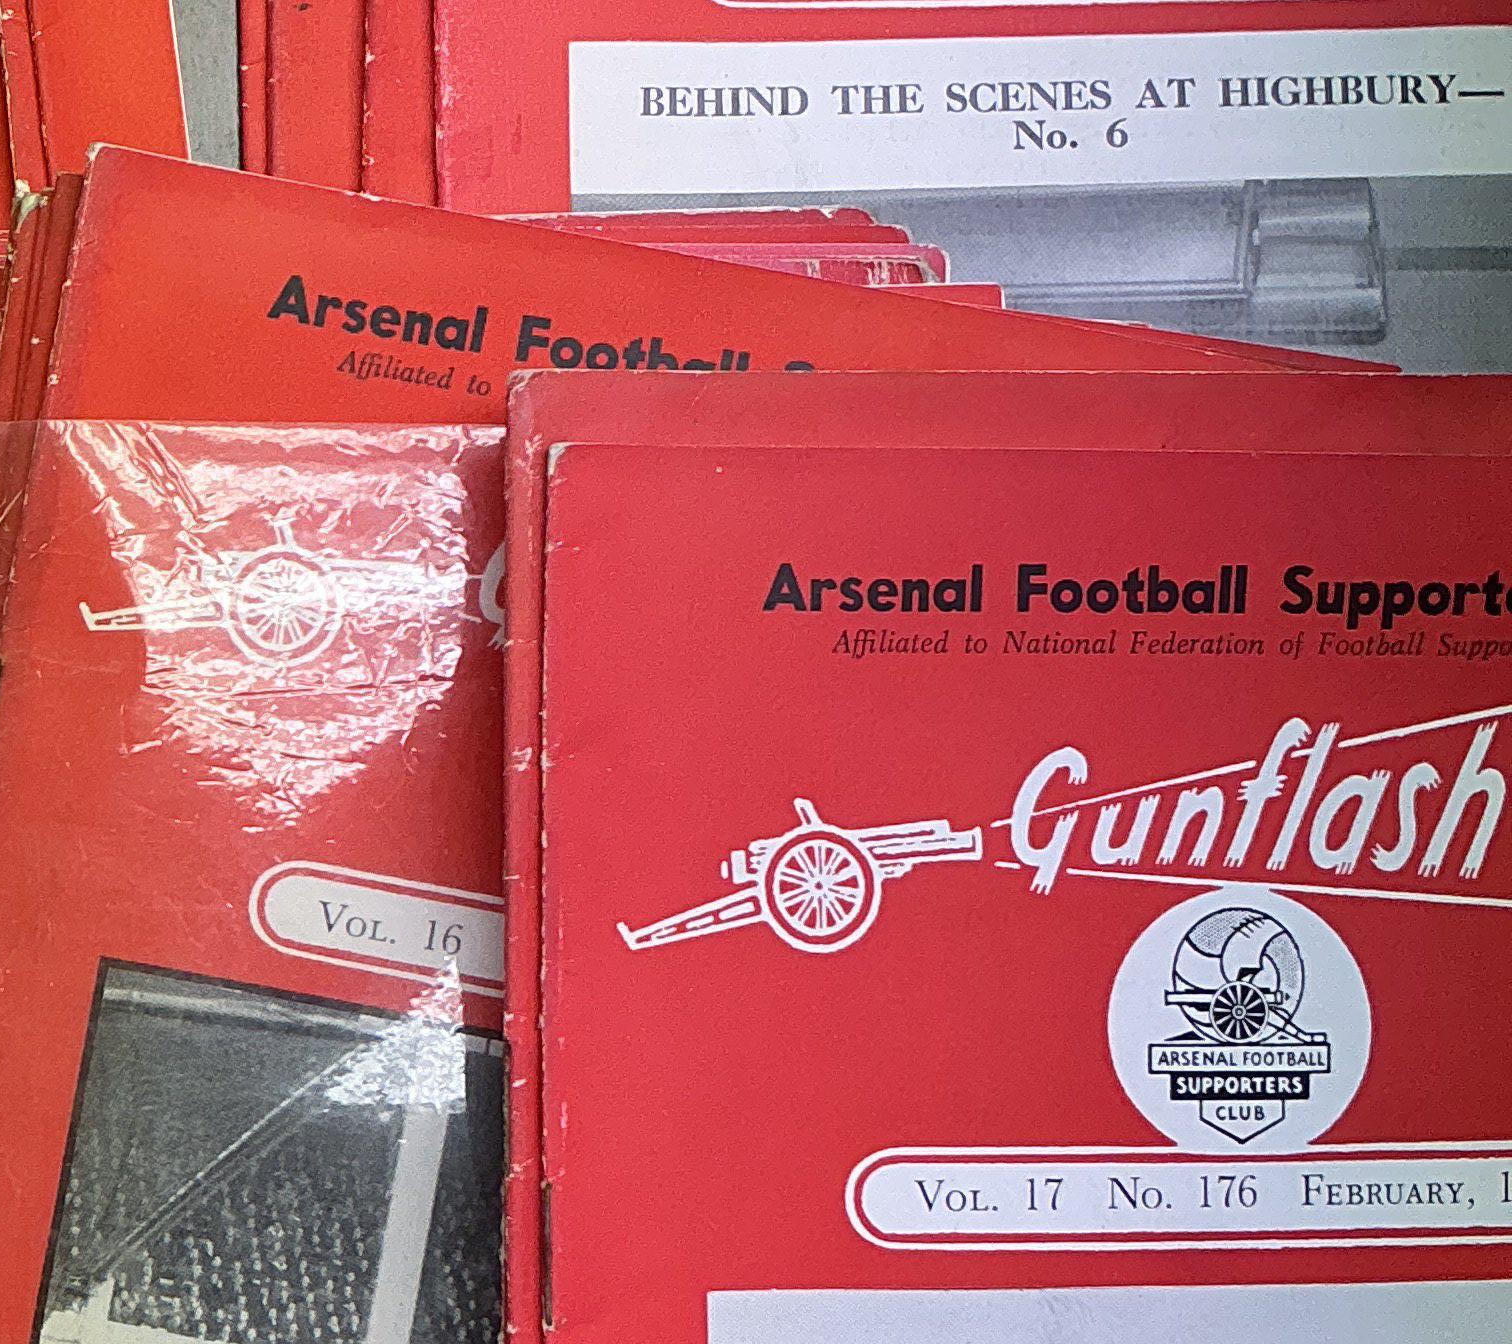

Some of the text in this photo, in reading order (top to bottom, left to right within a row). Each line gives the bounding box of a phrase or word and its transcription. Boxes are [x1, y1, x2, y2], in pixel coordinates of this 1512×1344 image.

[640, 77, 1196, 117] BEHIND THE SCENES AT
[1013, 117, 1129, 151] No. 6
[267, 274, 488, 353] Arsenal
[336, 349, 454, 391] Affiliated
[762, 562, 1249, 614] Arsenal Football
[832, 628, 1425, 659] Affiliated to National Federation of Football
[1010, 716, 1506, 895] Gunflash
[319, 900, 464, 955] VOL. 16
[1157, 1050, 1326, 1067] ARSENAL FOOTBALL
[1176, 1076, 1304, 1095] SUPPORTERS
[1215, 1105, 1266, 1122] CLUB
[914, 1173, 1476, 1213] VOL. 17 No. 176 FEBRUARY,
